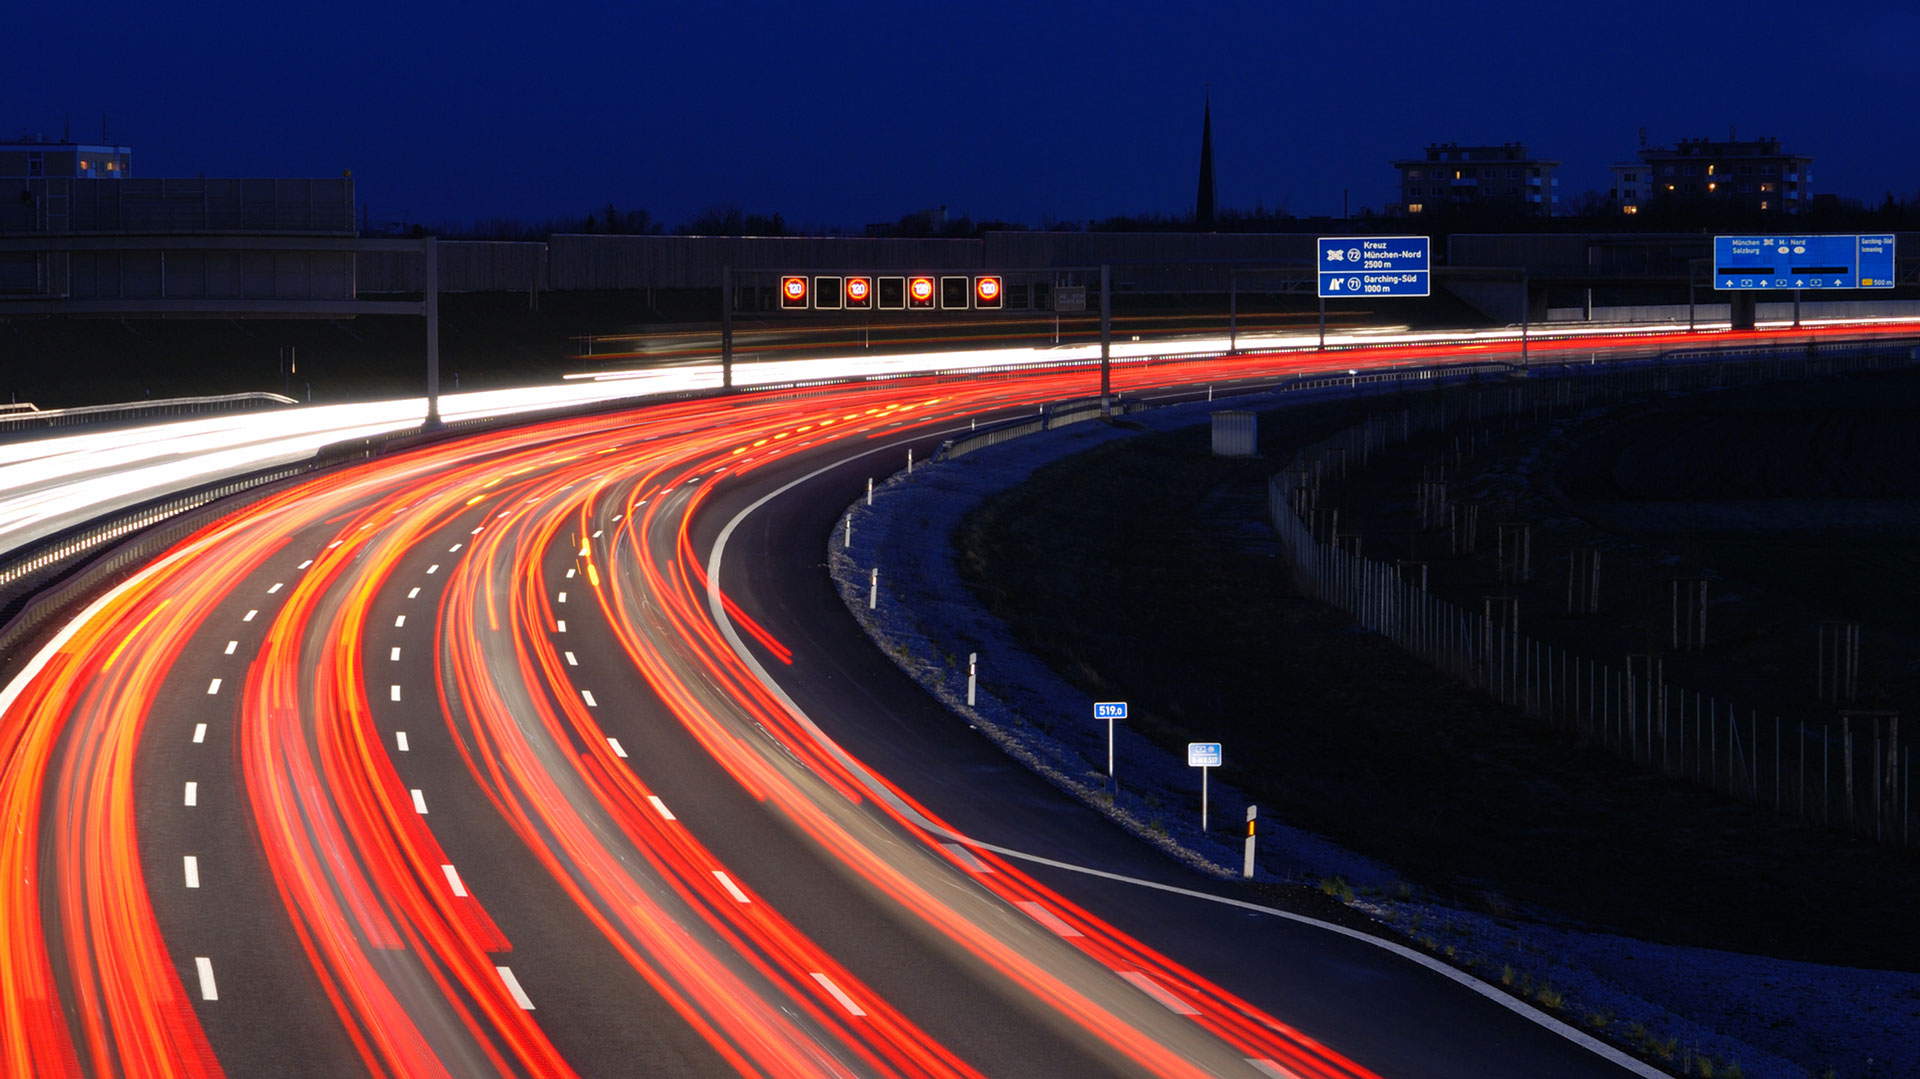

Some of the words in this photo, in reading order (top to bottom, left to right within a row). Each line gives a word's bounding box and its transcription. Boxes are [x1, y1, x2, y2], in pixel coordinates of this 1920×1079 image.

[1363, 241, 1387, 249] Kreuz
[1349, 251, 1359, 259] 72
[1363, 250, 1422, 259] München-Nord
[1732, 247, 1760, 255] Salzburg
[1364, 261, 1383, 269] 2500
[1364, 274, 1417, 284] Garching-Süd
[788, 282, 802, 294] 120
[981, 282, 996, 294] 120
[1350, 280, 1358, 288] 71
[851, 283, 865, 295] 120
[1099, 705, 1122, 716] 519,0
